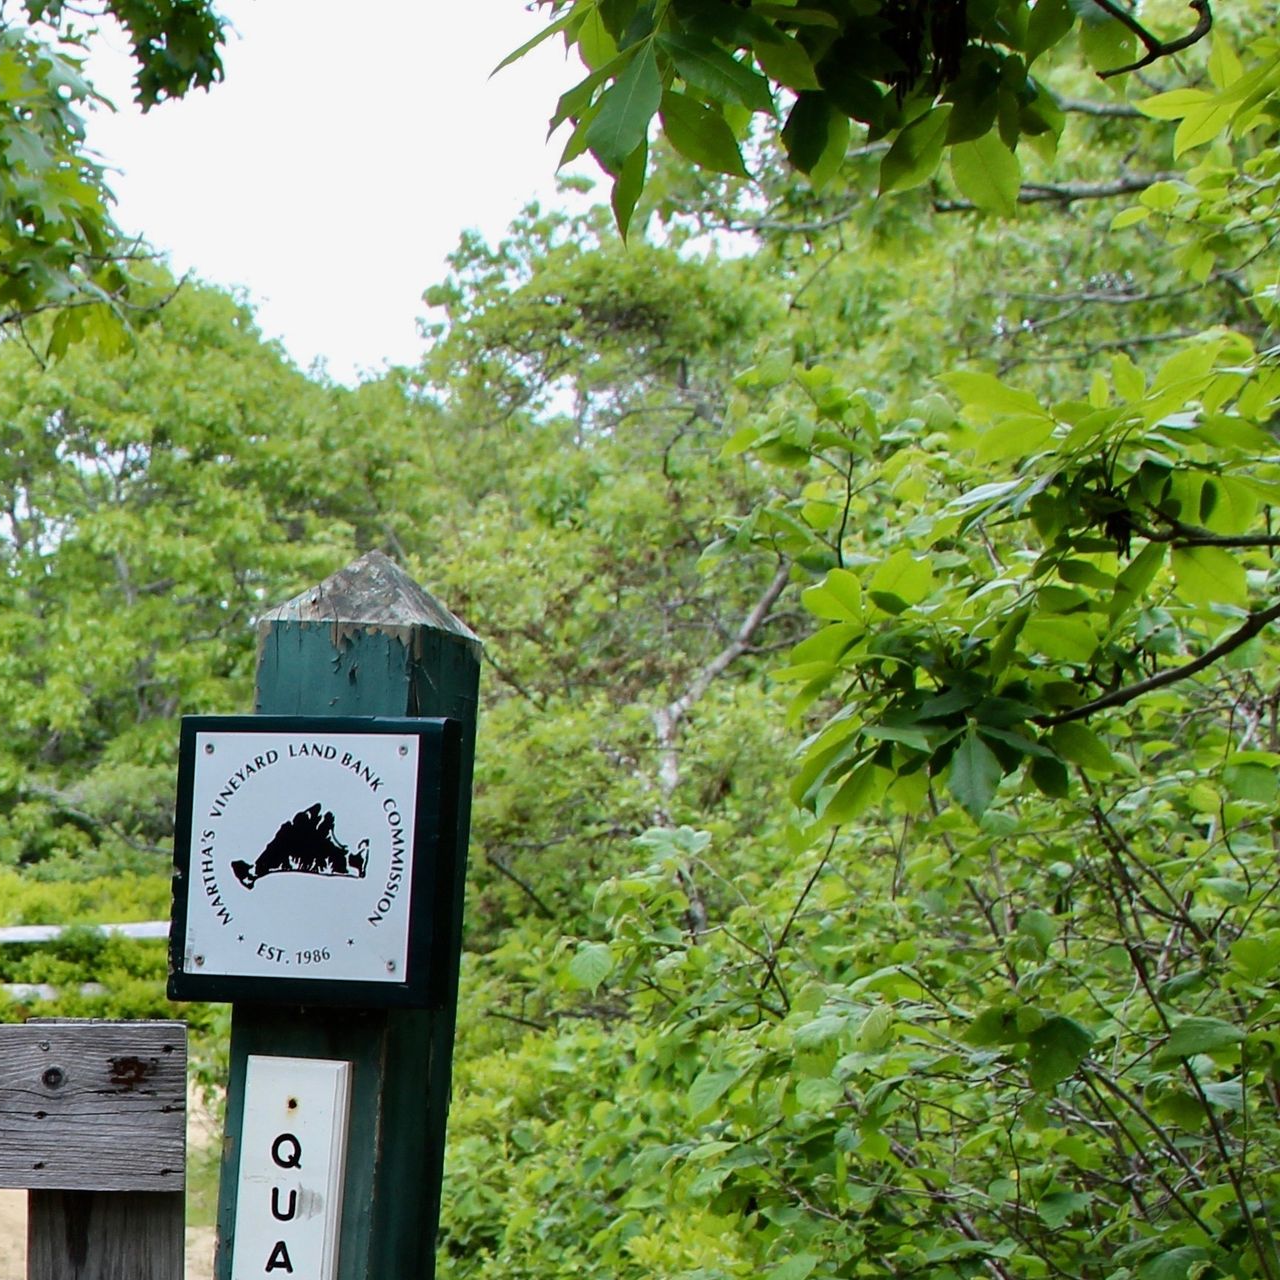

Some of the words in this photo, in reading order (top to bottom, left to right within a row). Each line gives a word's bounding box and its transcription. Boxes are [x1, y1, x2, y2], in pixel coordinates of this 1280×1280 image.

[288, 743, 338, 761] LAND
[340, 752, 385, 792] BANK
[209, 749, 279, 818] VINEYARD
[200, 830, 233, 926] MARTHA'S
[367, 798, 406, 927] COMMISSION
[256, 943, 290, 964] EST.
[296, 947, 331, 964] 1986
